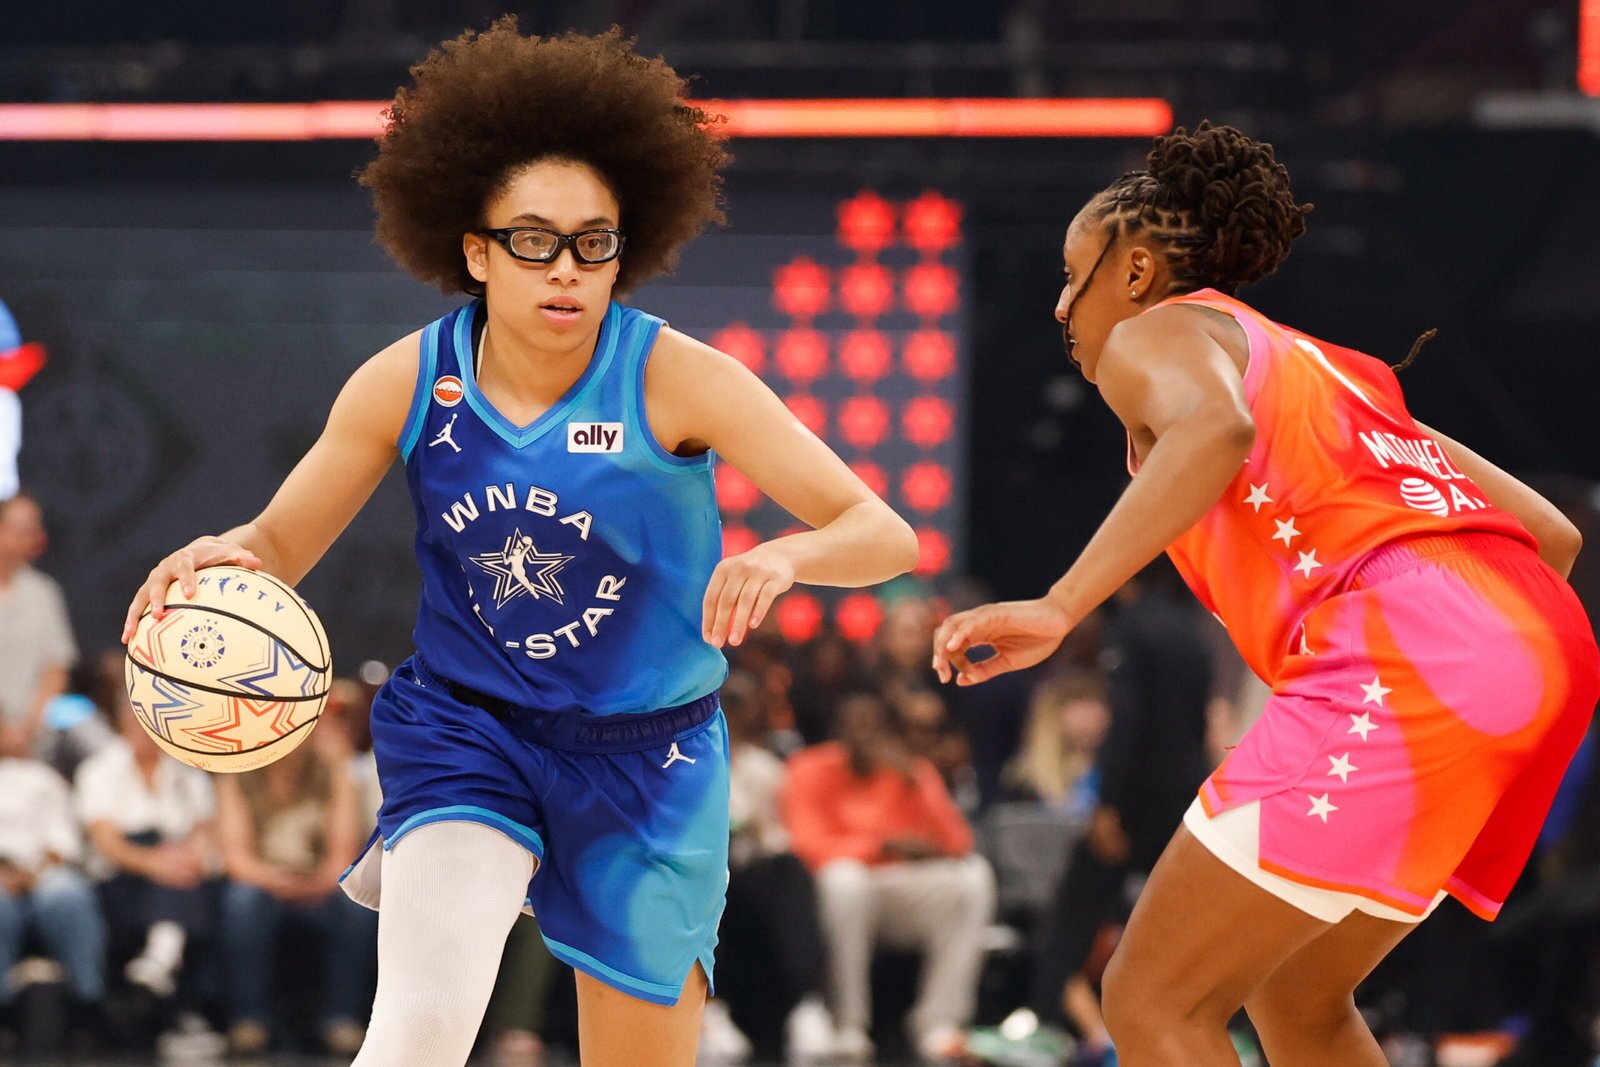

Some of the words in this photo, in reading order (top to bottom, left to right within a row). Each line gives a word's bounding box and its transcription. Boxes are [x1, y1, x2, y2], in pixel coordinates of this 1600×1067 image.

[573, 424, 618, 451] ally
[1358, 430, 1474, 483] MITCHEL
[441, 482, 593, 541] WNBA
[463, 572, 627, 660] -STAR
